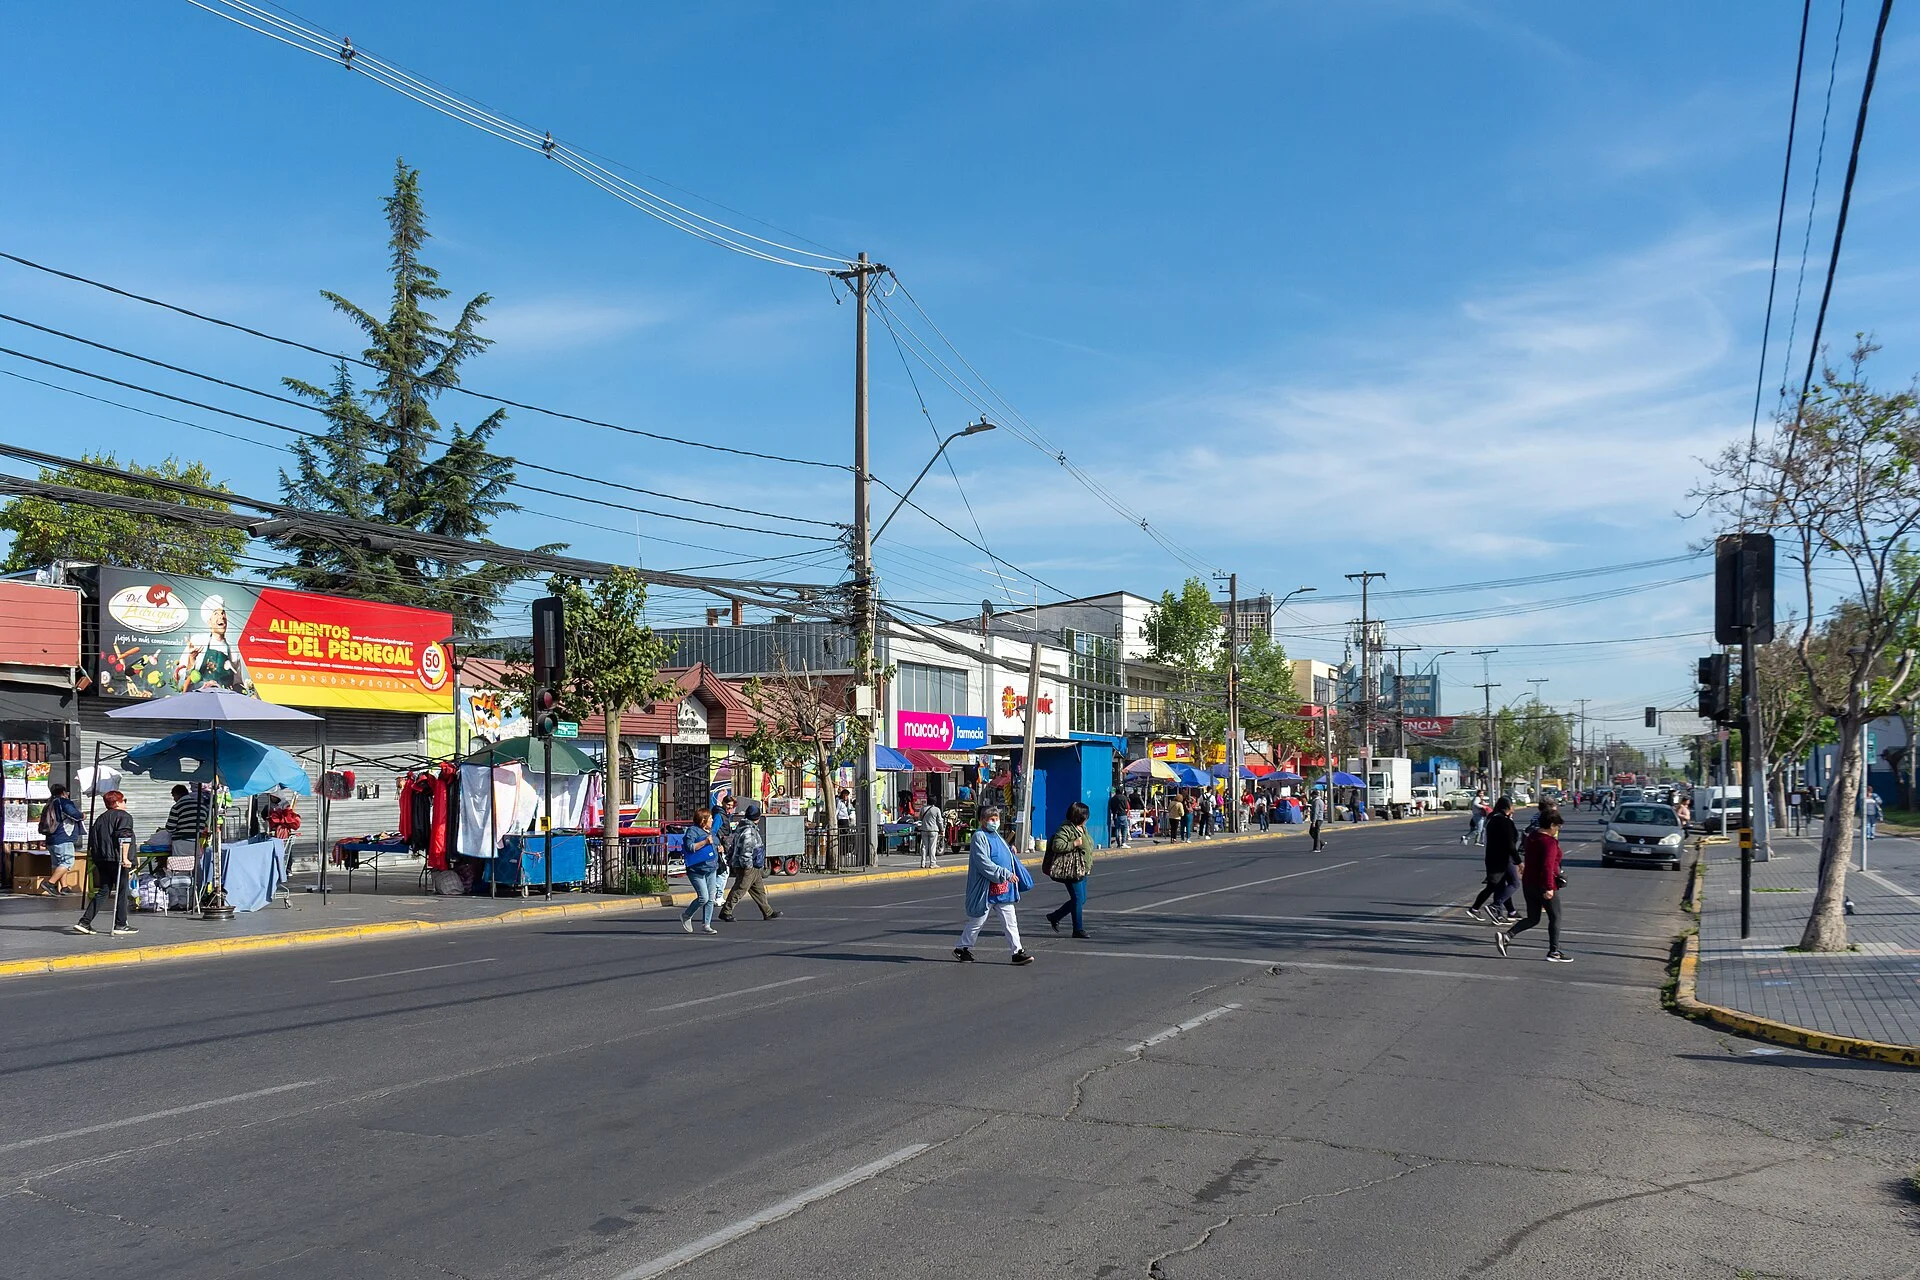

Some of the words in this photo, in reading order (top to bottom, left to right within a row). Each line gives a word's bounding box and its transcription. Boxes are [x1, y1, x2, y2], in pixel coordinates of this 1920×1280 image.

[126, 593, 142, 603] Del
[269, 619, 350, 640] ALIMENTOS
[287, 635, 324, 658] DEL
[328, 639, 414, 667] PEDREGAL
[904, 722, 940, 739] maicao
[956, 726, 984, 740] farmacia
